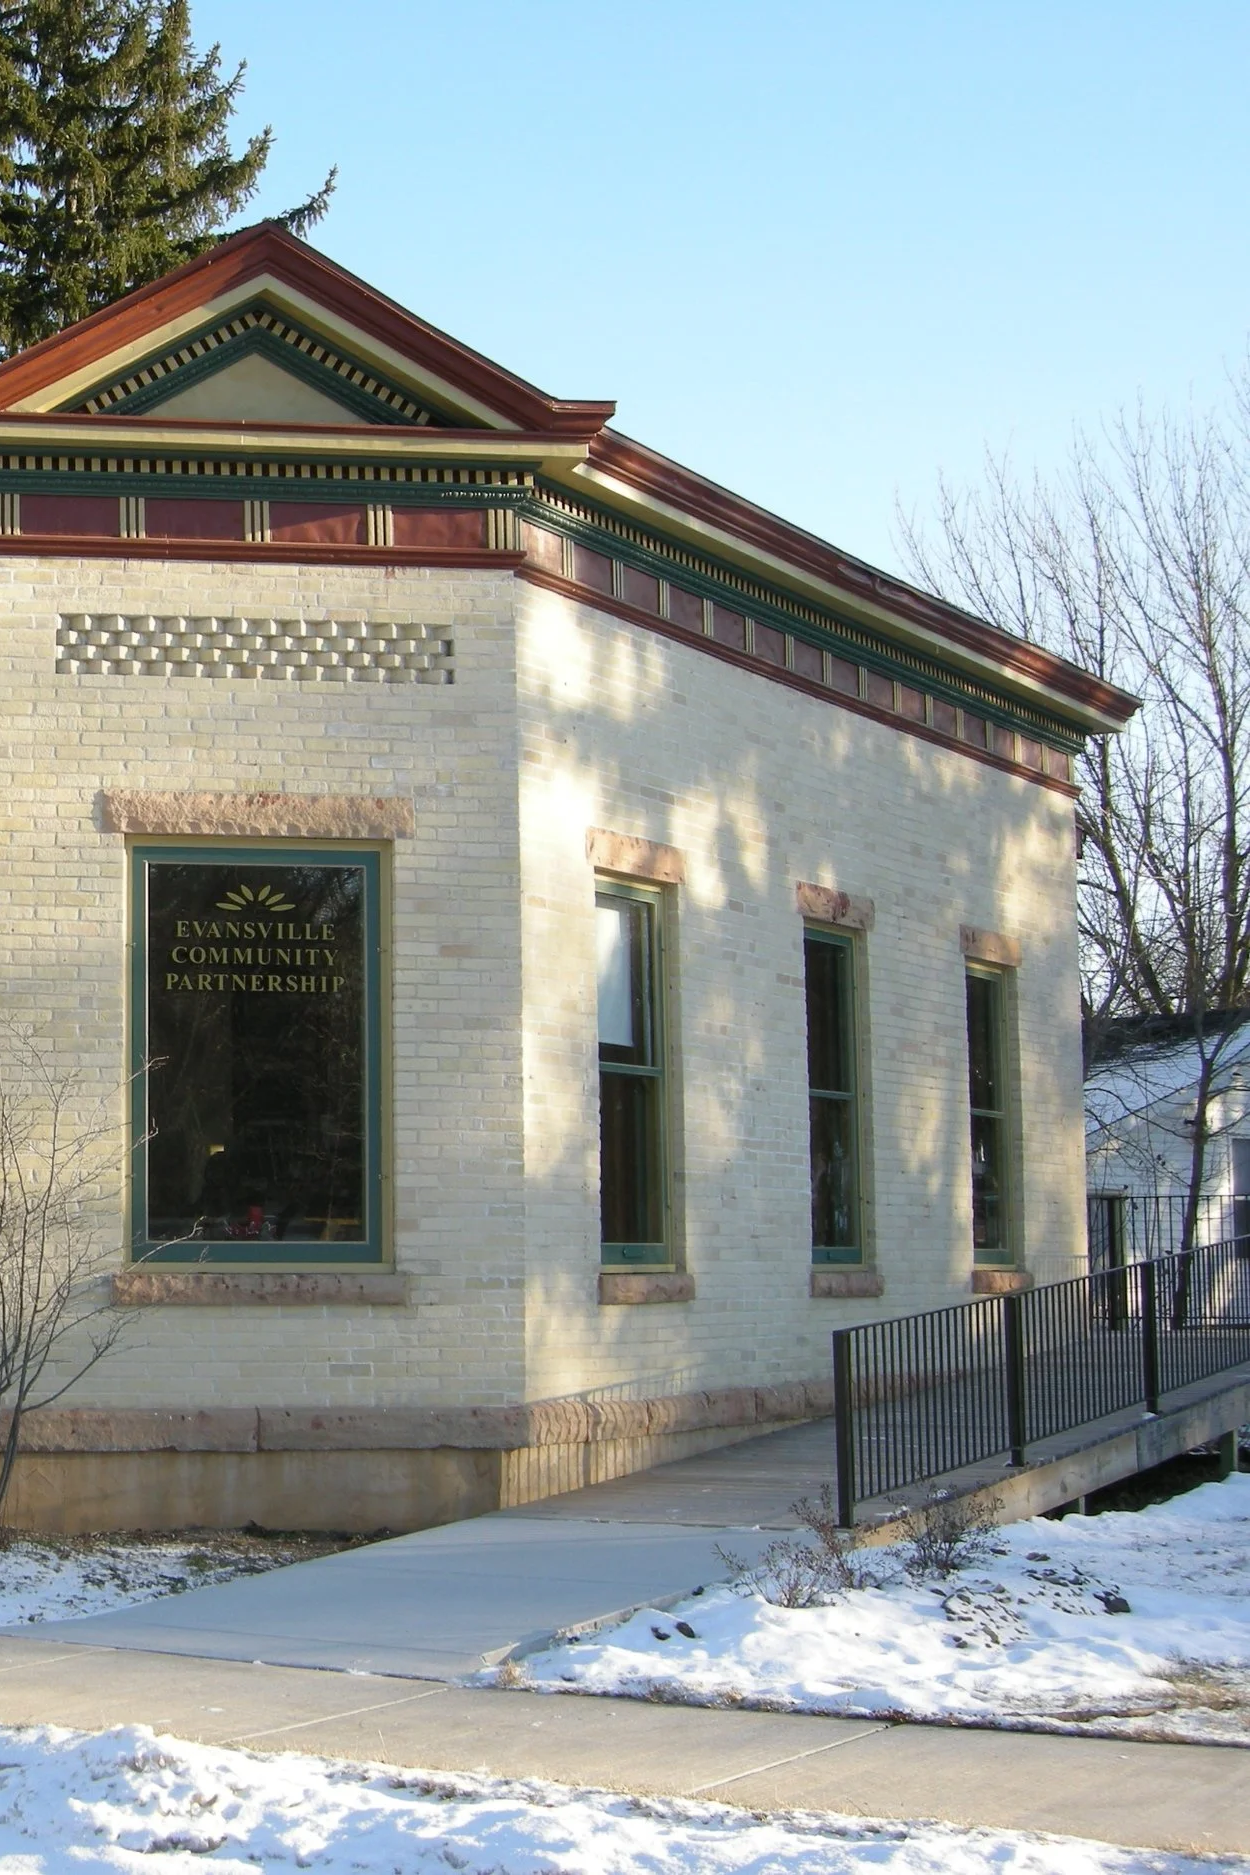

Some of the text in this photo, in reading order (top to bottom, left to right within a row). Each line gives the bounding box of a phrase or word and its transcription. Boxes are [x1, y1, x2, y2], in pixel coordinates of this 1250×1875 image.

[175, 920, 336, 941] EVANSVILLE
[171, 946, 339, 966] COMMUNITY
[165, 973, 345, 993] PARTNERSHIP
